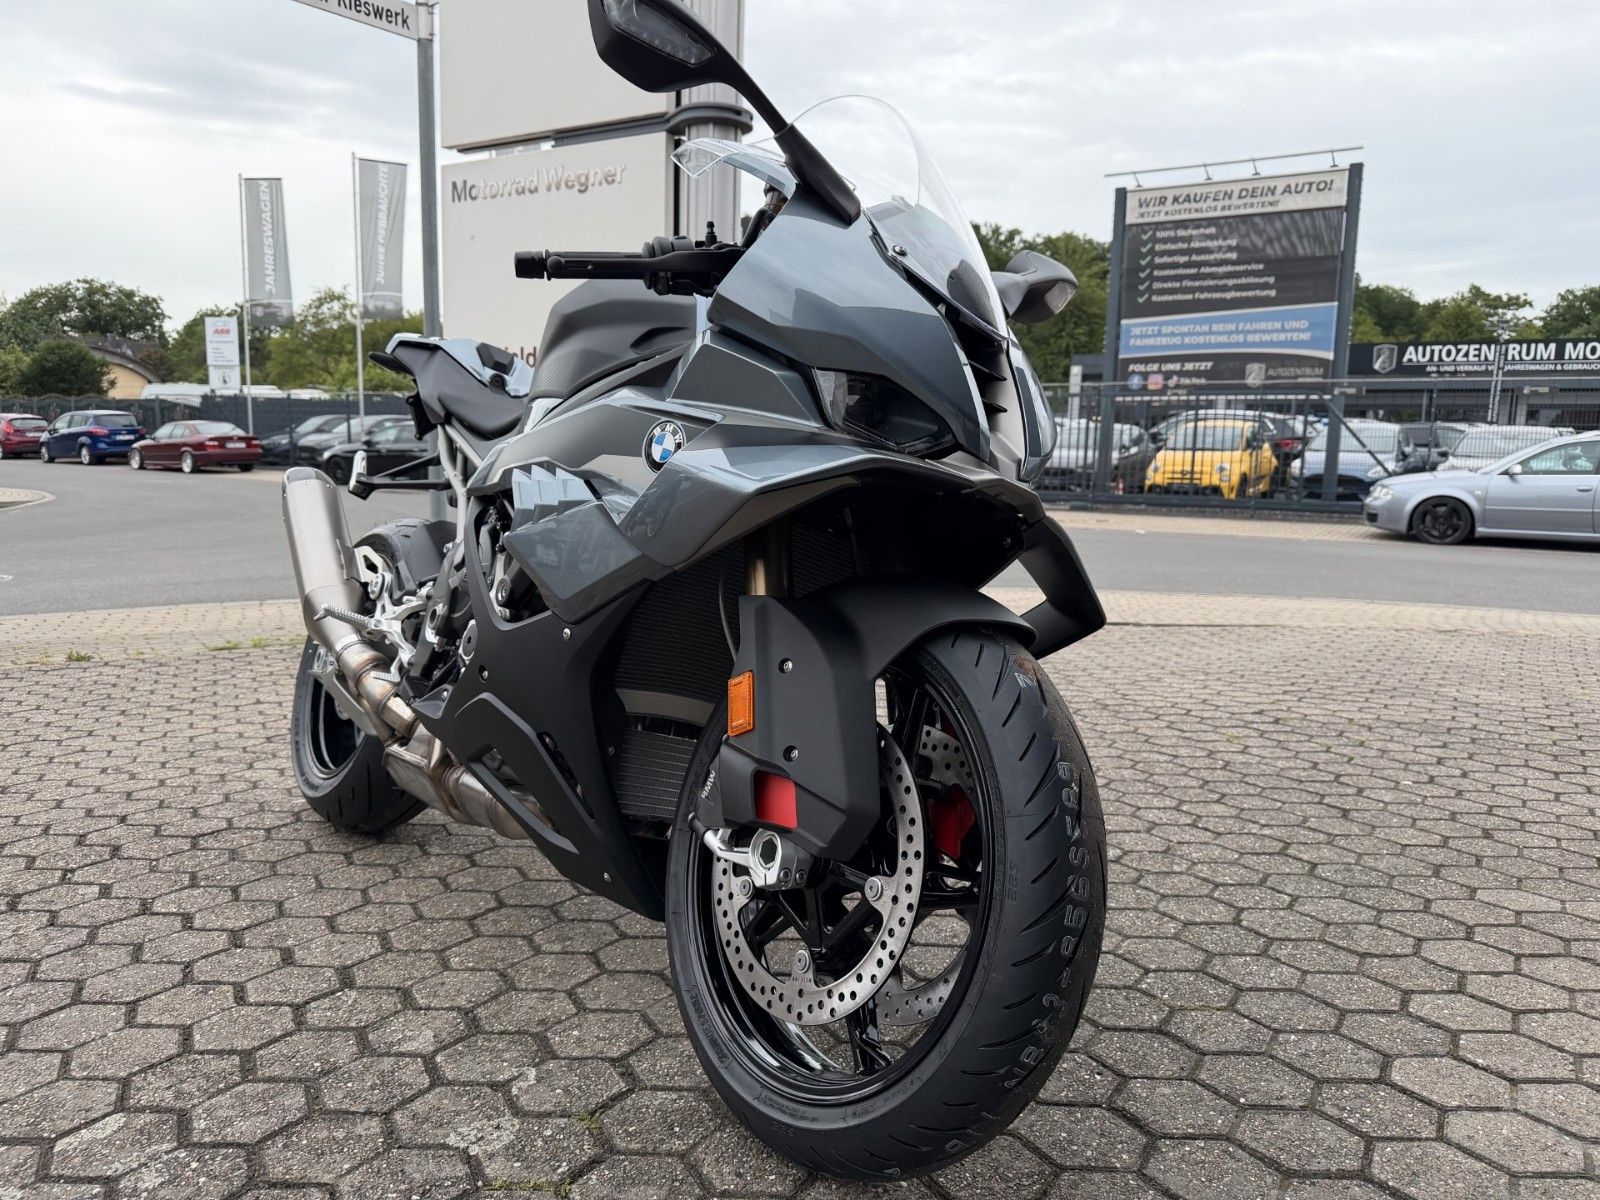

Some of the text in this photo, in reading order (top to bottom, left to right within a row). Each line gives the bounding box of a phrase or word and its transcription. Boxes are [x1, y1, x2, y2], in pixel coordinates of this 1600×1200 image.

[451, 163, 628, 204] Motorrad Wegner
[1138, 179, 1335, 209] WIR KAUFEN DEIN AUTO!
[1137, 209, 1162, 219] JETZT
[1164, 204, 1218, 217] KOSTENLOS
[258, 180, 276, 295] JAHRESWAGEN
[1155, 227, 1217, 239] 100% Sicherheit
[1154, 238, 1238, 252] Einfache Abwicklung
[1153, 251, 1238, 265] Sofortige Auszahlung
[1153, 262, 1265, 277] Kostenloser Abmeldeservice
[1152, 280, 1182, 290] Direkte
[1151, 288, 1277, 302] Kostenlose Fahrzeugbewertung
[1129, 319, 1309, 336] JETZT SPONTAN REIN FAHREN UND
[1129, 336, 1182, 347] FAHRZEUG
[1184, 333, 1244, 345] KOSTENLOS
[1402, 342, 1556, 363] AUTOZENRUM
[1128, 360, 1215, 373] FOLGE UNS JETZT
[1457, 364, 1487, 372] VERKAUF
[1504, 362, 1555, 372] JAHRESWAGEN
[701, 769, 716, 799] BMW
